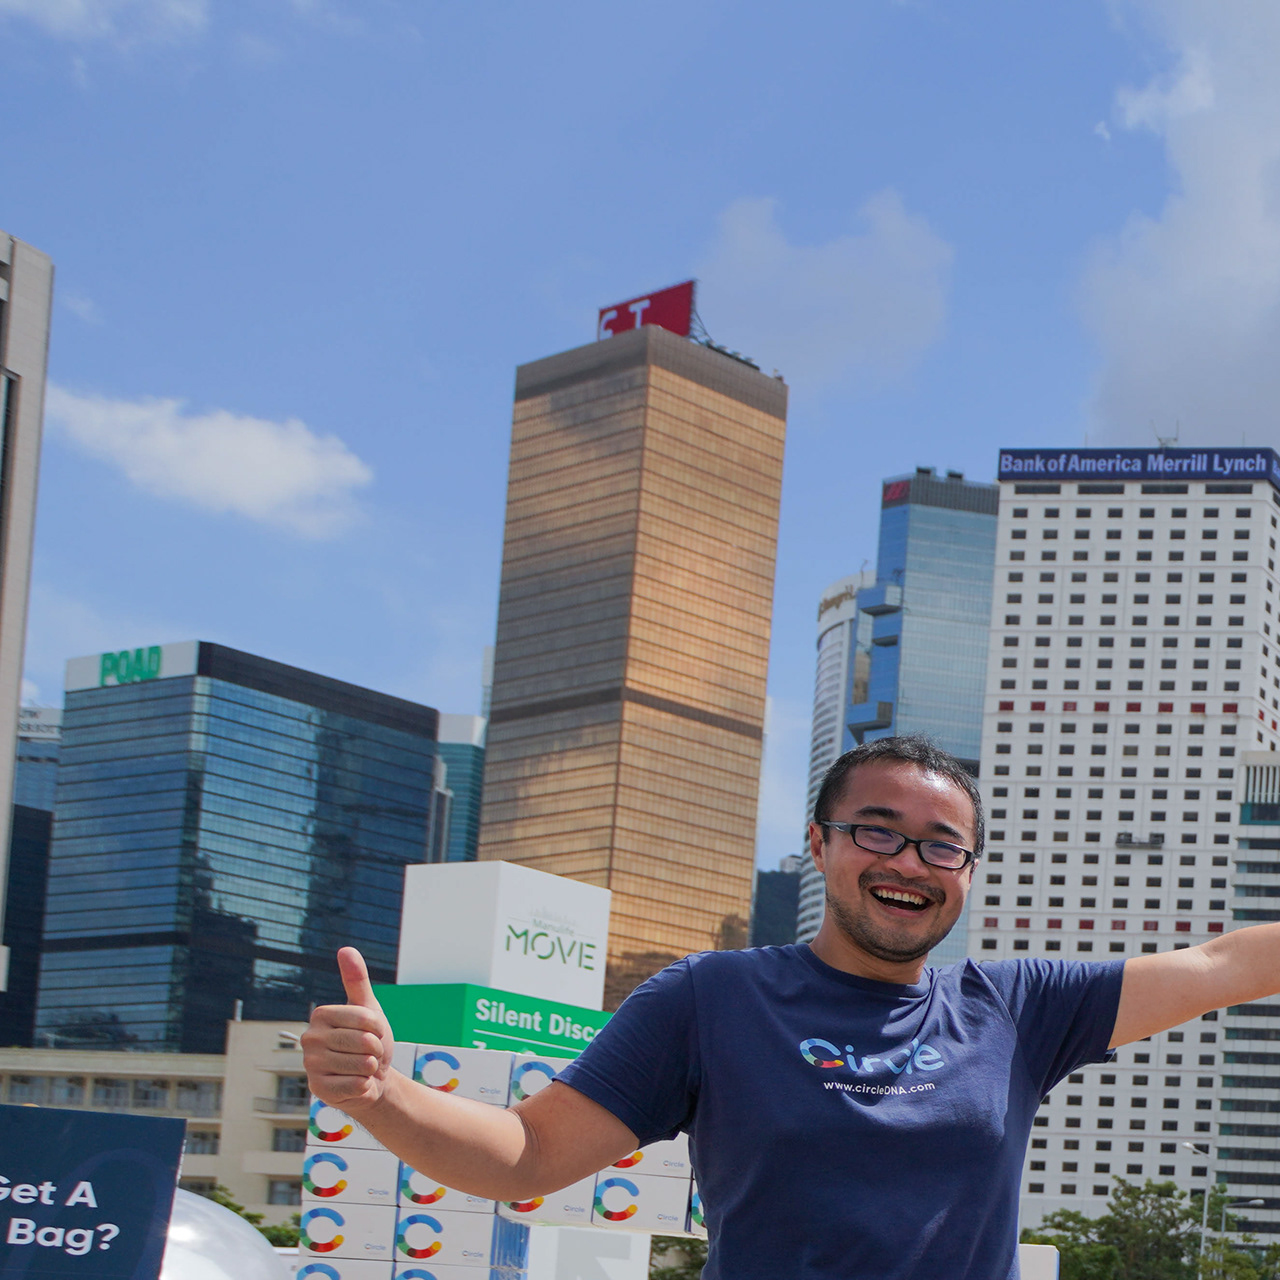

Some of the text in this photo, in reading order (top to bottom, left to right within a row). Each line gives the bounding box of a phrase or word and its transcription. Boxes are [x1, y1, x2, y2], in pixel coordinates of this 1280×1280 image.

[1000, 454, 1267, 474] Bank of America Merrill Lynch
[506, 924, 596, 971] MOVE
[475, 998, 543, 1032] Silent
[799, 1038, 945, 1075] Circle
[823, 1081, 936, 1096] www.circleDNA.com
[66, 1181, 98, 1209] A
[7, 1217, 120, 1256] Bag?
